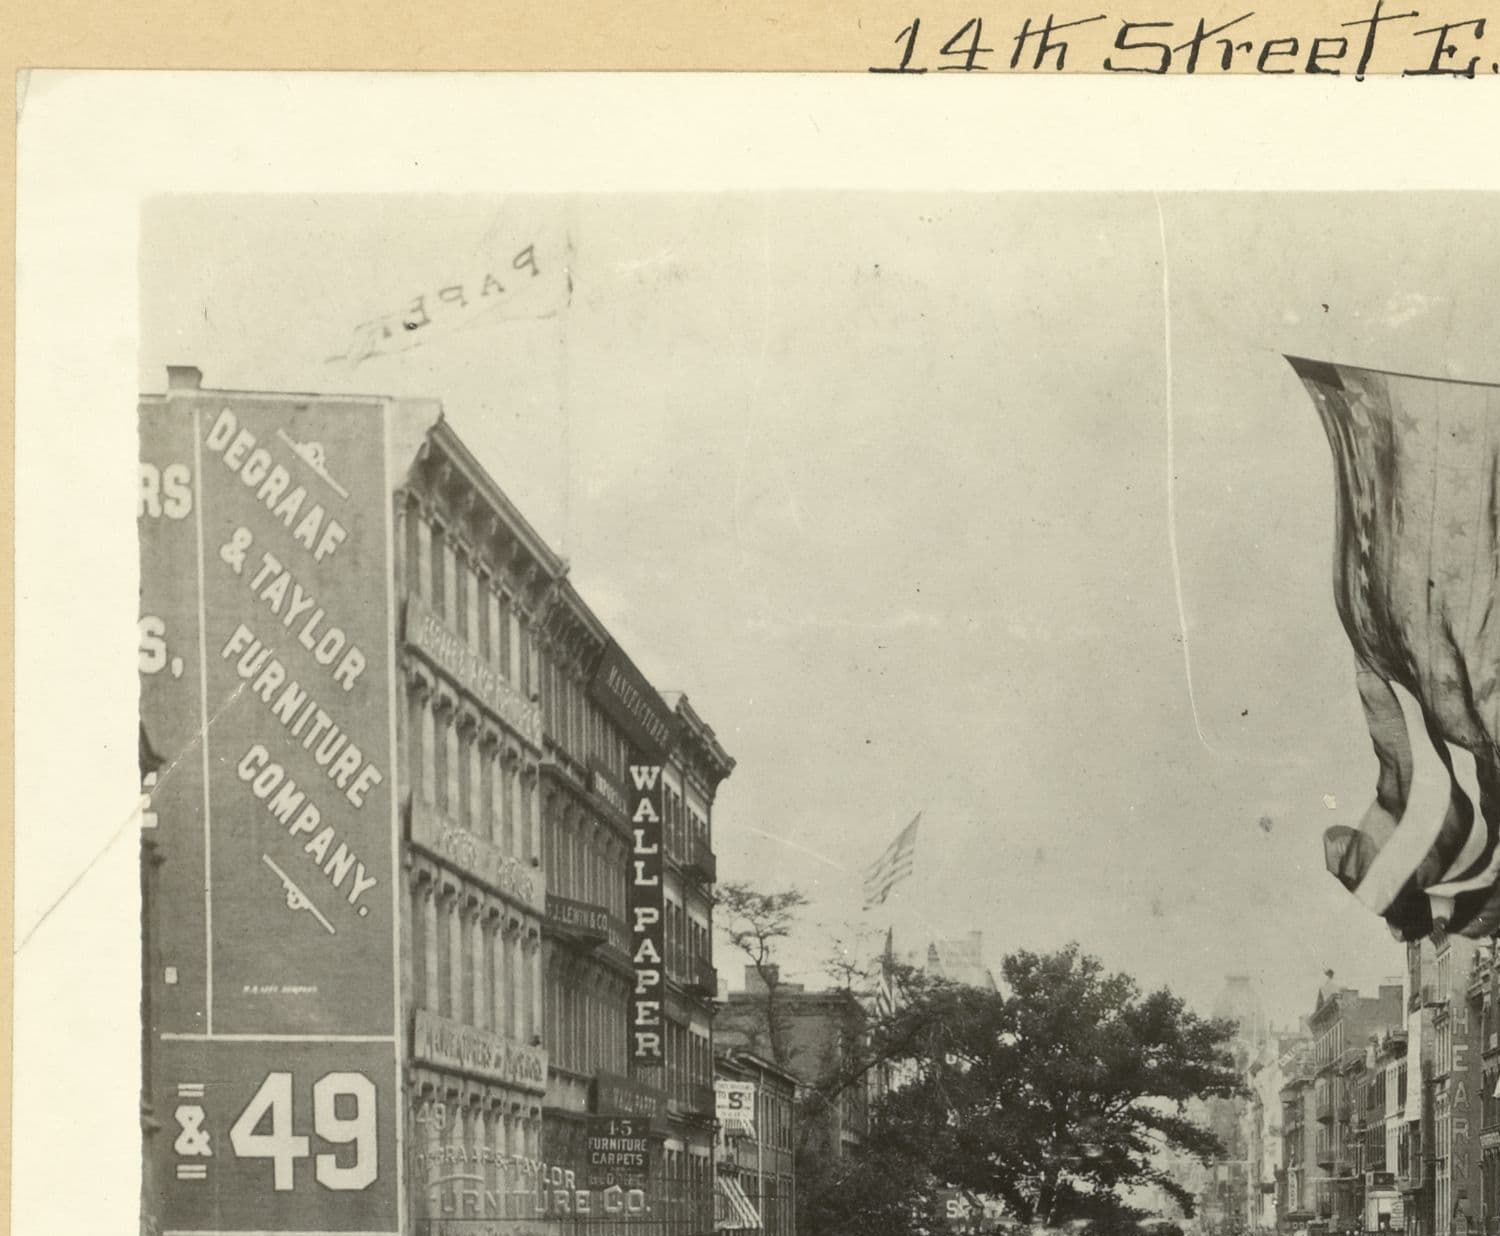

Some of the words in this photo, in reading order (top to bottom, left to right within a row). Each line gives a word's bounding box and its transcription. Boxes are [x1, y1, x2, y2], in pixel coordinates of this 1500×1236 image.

[869, 15, 1105, 73] 14th
[1104, 0, 1419, 81] Street
[206, 406, 347, 562] DEGRAAF
[220, 527, 253, 574] &
[250, 551, 367, 692] TAYLOR
[221, 623, 383, 809] FURNITURE
[238, 744, 377, 917] COMPANY.
[629, 765, 661, 885] WALL
[633, 907, 662, 1057] PAPER
[174, 1104, 213, 1157] &
[229, 1071, 378, 1191] 49
[588, 1137, 648, 1152] FURNITURE
[591, 1152, 644, 1166] CARPETS
